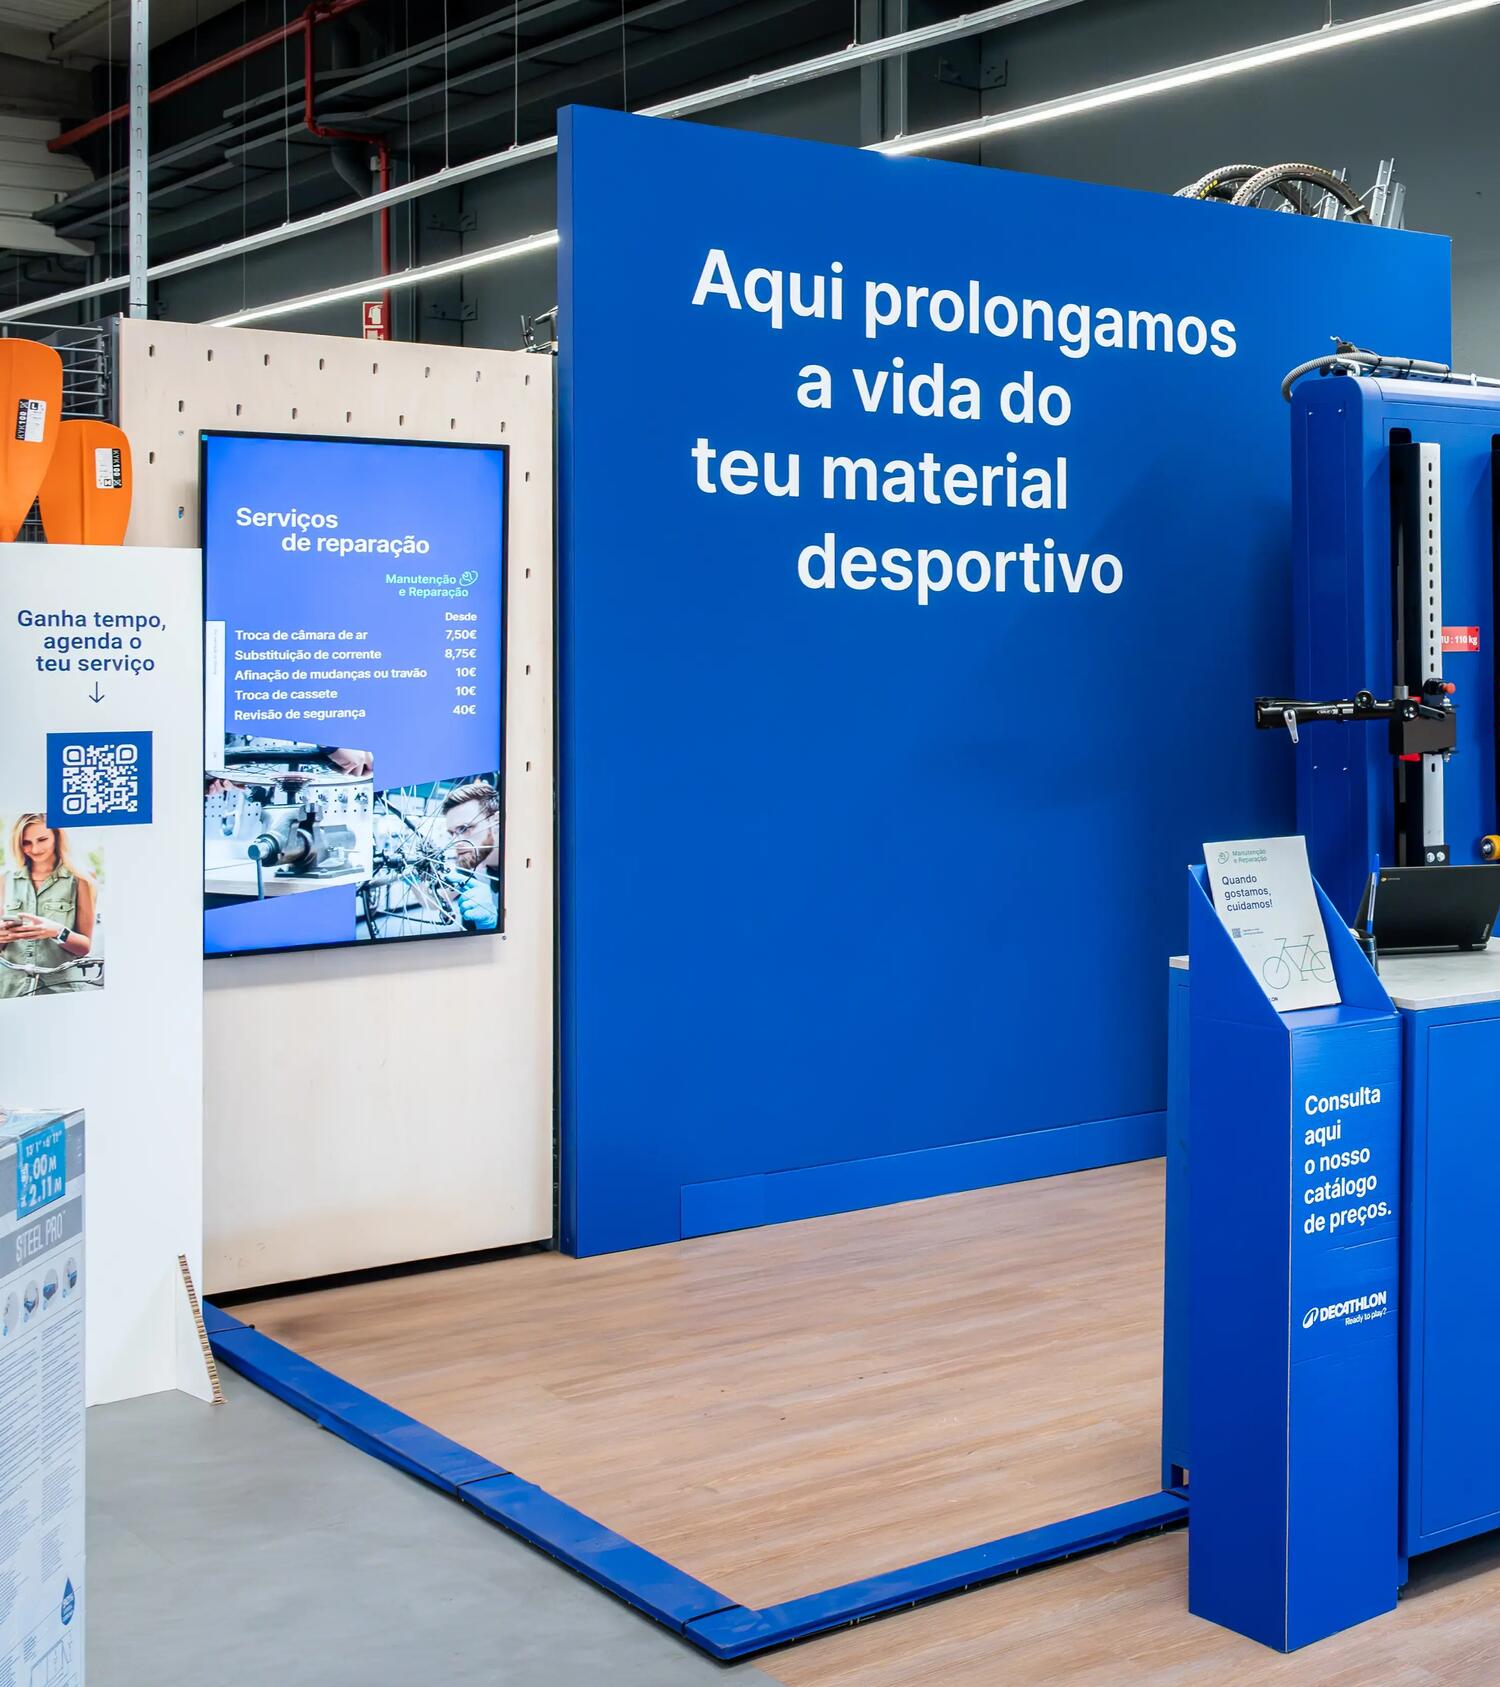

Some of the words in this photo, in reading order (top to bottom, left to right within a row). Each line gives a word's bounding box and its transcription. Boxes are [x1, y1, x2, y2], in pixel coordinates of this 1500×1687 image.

[692, 249, 843, 328] Aqui
[865, 280, 1237, 358] prolongamos
[797, 365, 832, 409] a
[852, 357, 981, 420] vida
[1000, 371, 1071, 426] do
[692, 438, 799, 497] teu
[823, 452, 1068, 510] material
[236, 508, 339, 532] Serviços
[282, 533, 311, 551] de
[317, 536, 430, 558] reparação
[797, 533, 1123, 606] desportivo
[386, 574, 456, 586] Manutenção
[399, 589, 406, 597] e
[409, 587, 469, 599] Reparação
[17, 609, 87, 628] Ganha
[94, 611, 166, 632] tempo,
[445, 613, 477, 621] Desde
[43, 632, 122, 653] agenda
[129, 636, 142, 649] o
[235, 630, 269, 641] Troca
[273, 630, 288, 640] de
[291, 630, 336, 641] câmara
[338, 630, 353, 640] de
[356, 632, 368, 640] ar
[445, 630, 477, 641] 7,50€
[1469, 636, 1477, 645] kg
[235, 650, 311, 661] Substituição
[314, 651, 329, 660] de
[332, 651, 381, 659] corrente
[445, 649, 477, 660] 8,75€
[36, 656, 71, 672] teu
[77, 654, 155, 676] serviço
[456, 668, 476, 677] 10€
[235, 670, 289, 681] Afinação
[292, 670, 307, 679] de
[310, 669, 371, 680] mudanças
[374, 670, 388, 679] ou
[391, 668, 427, 678] travão
[235, 690, 269, 700] Troca
[272, 690, 288, 699] de
[290, 689, 338, 698] cassete
[456, 686, 476, 696] 10€
[234, 710, 282, 720] Revisão
[285, 709, 301, 719] de
[304, 709, 365, 720] segurança
[453, 705, 476, 715] 40€
[1222, 874, 1257, 885] Quando
[1225, 888, 1271, 900] gostamos,
[1227, 899, 1273, 912] cuidamos!
[1305, 1086, 1381, 1115] Consulta
[1305, 1120, 1341, 1147] aqui
[1304, 1159, 1315, 1174] o
[1320, 1148, 1370, 1171] nosso
[1304, 1175, 1377, 1205] catálogo
[1304, 1214, 1325, 1235] de
[1330, 1201, 1391, 1233] preços.
[16, 1224, 42, 1263] STEEL
[45, 1214, 62, 1246] PRO
[1320, 1291, 1386, 1321] DECATHLON
[1345, 1316, 1363, 1326] Ready
[1371, 1307, 1387, 1321] play?
